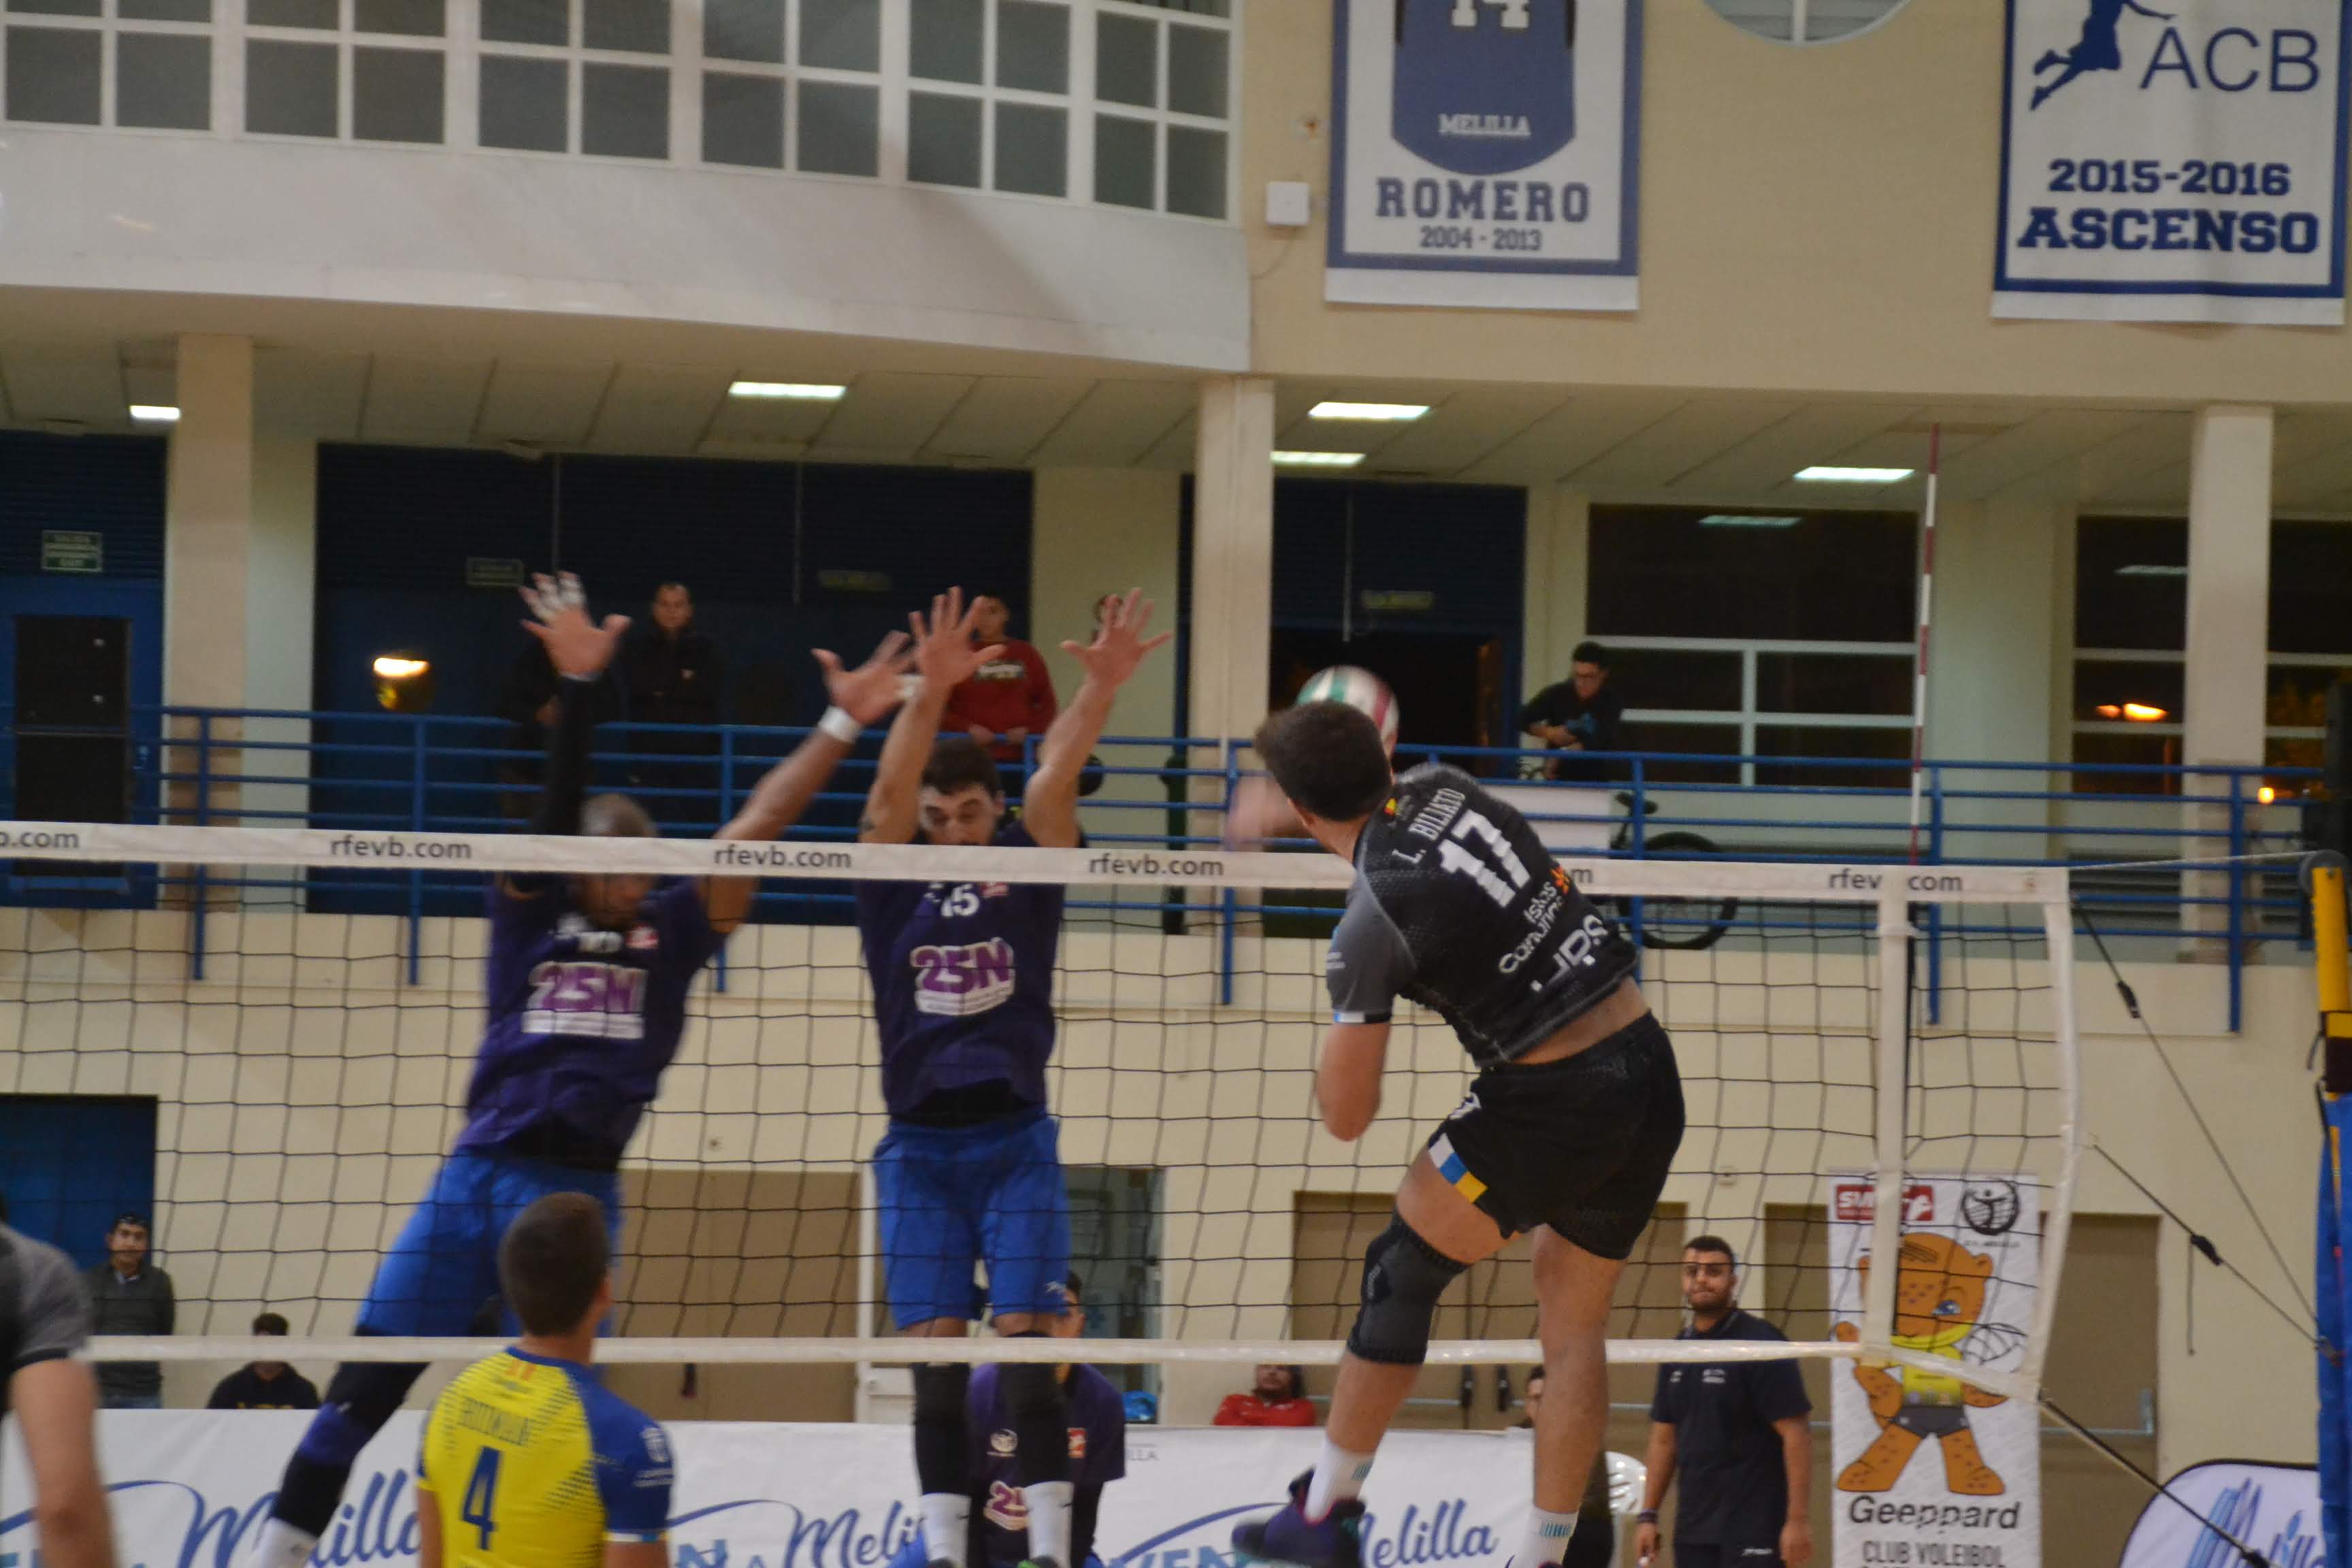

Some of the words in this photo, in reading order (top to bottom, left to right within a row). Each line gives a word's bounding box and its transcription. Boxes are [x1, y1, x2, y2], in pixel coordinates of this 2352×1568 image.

[2139, 27, 2319, 92] ACB
[1438, 113, 1531, 136] MELILLA
[2048, 159, 2291, 196] 2015-2016
[1375, 177, 1590, 223] ROMERO
[1420, 225, 1473, 248] 2004
[1492, 228, 1541, 251] 2013
[2016, 207, 2319, 254] ASCENSO
[330, 834, 472, 860] rfevb.com
[714, 846, 852, 869] rfevb.com
[1437, 810, 1531, 908] 17
[1090, 855, 1224, 877] rfevb.com
[1829, 868, 1963, 892] rfevcom
[913, 938, 1013, 994] 25N
[462, 1446, 503, 1551] 4
[1849, 1494, 2022, 1533] Geeppard
[1863, 1541, 1908, 1563] CLUB
